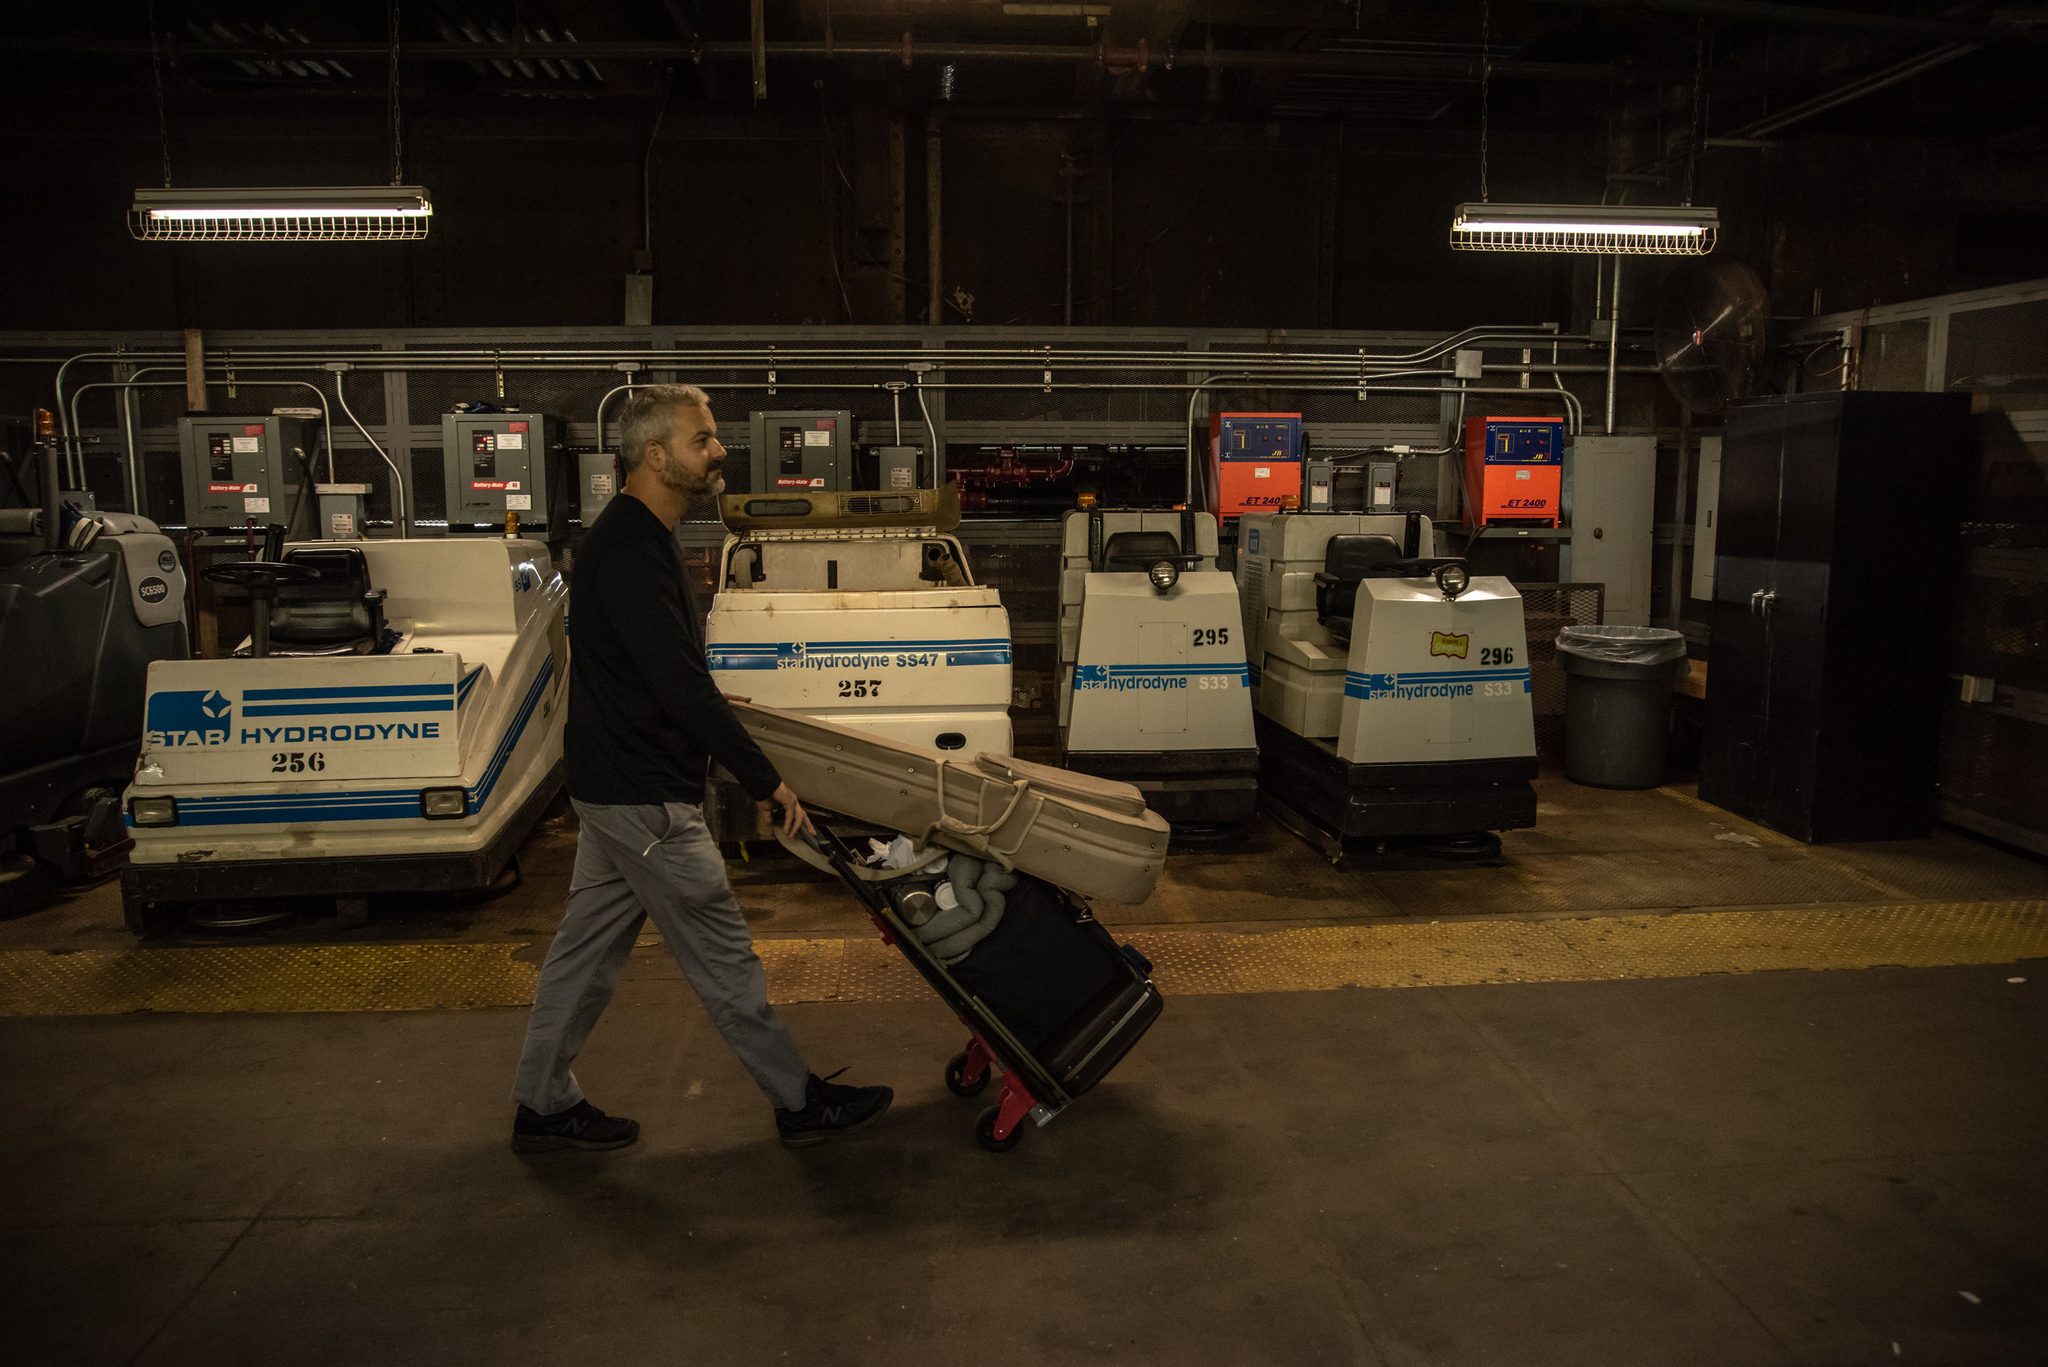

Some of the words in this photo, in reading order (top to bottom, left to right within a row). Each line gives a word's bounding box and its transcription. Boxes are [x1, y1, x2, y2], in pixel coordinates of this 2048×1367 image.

[1193, 628, 1229, 646] 295
[805, 654, 889, 670] hydrodyne
[896, 654, 938, 667] SS47
[1481, 648, 1513, 665] 296
[838, 680, 882, 698] 257
[1109, 675, 1187, 692] hydrodyne
[1199, 676, 1229, 690] S33
[1397, 683, 1473, 700] hydrodyne
[1484, 681, 1513, 697] S33
[147, 729, 226, 746] STAR
[241, 722, 440, 744] HYDRODYNE
[271, 752, 326, 773] 256
